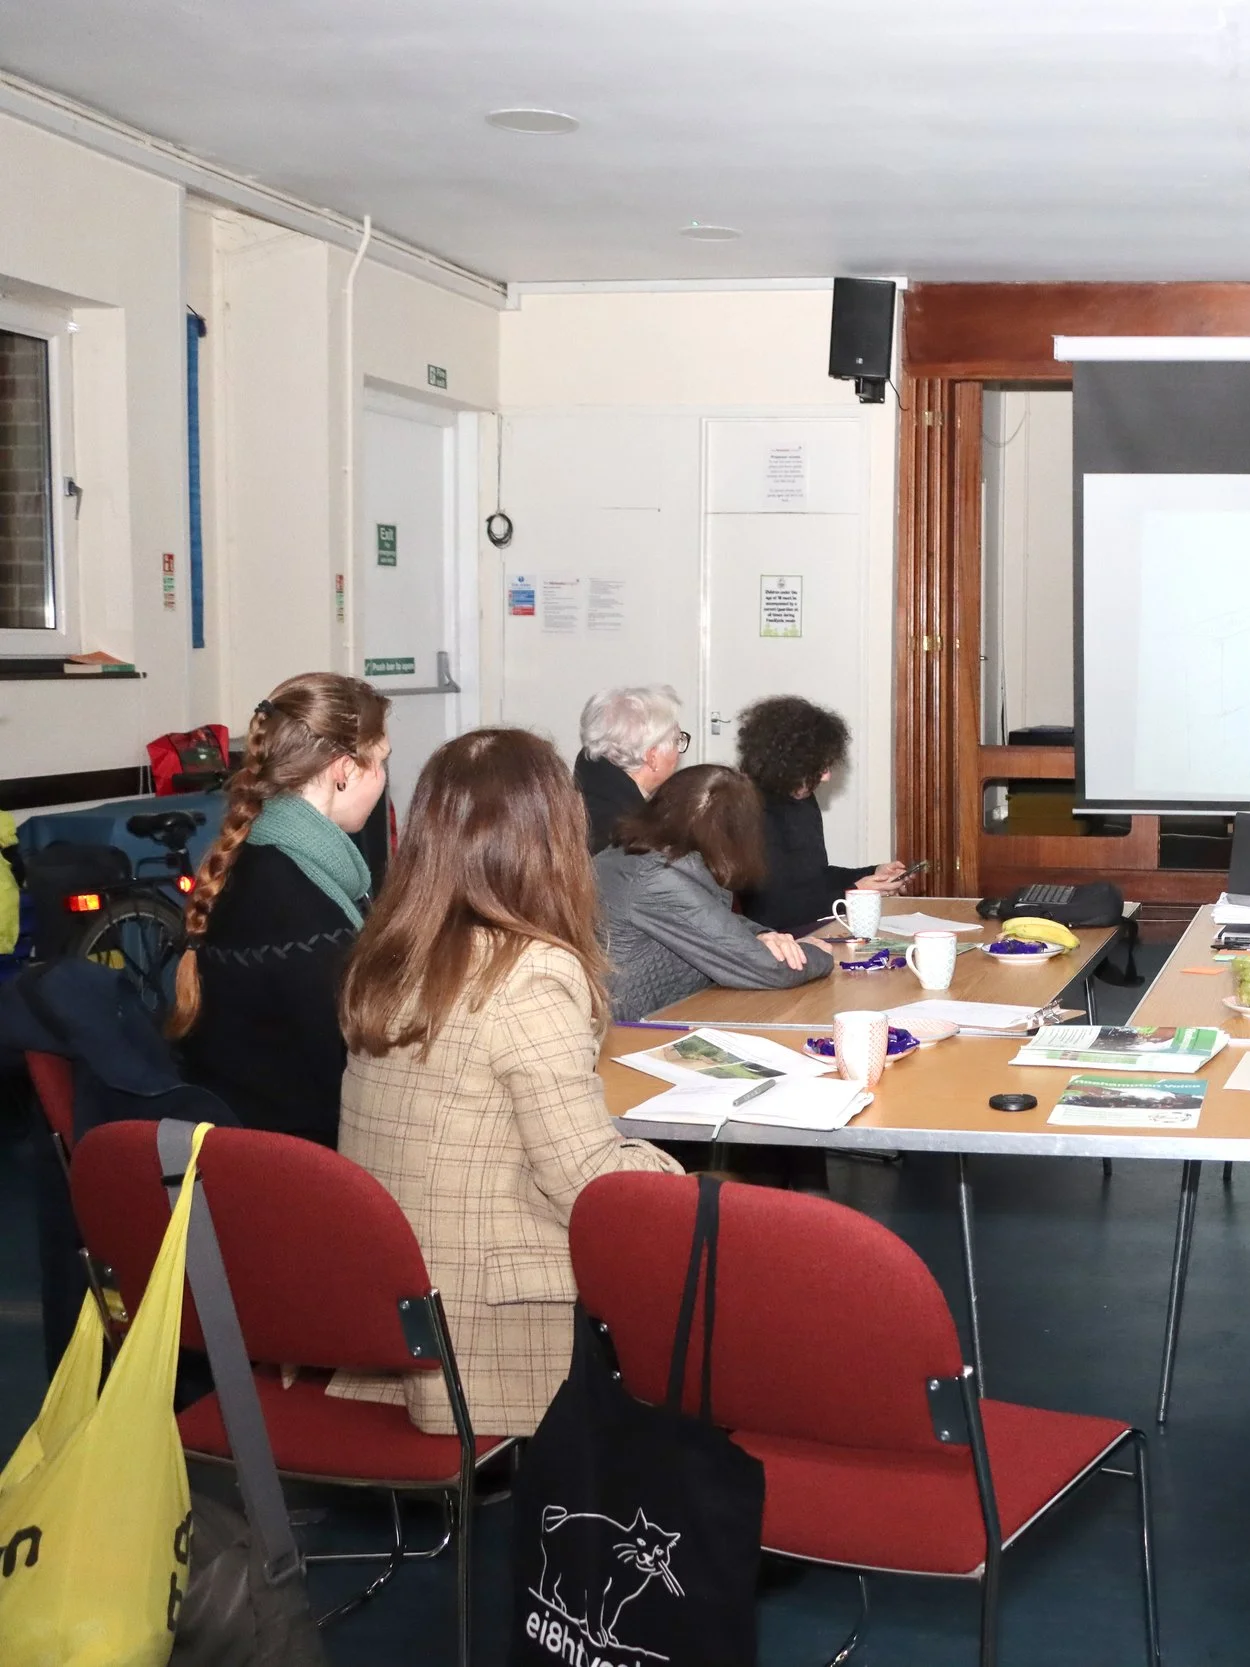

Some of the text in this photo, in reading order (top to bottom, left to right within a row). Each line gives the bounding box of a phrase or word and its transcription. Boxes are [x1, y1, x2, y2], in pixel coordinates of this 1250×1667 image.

[380, 527, 394, 541] Exit
[372, 662, 414, 671] Push bar to open
